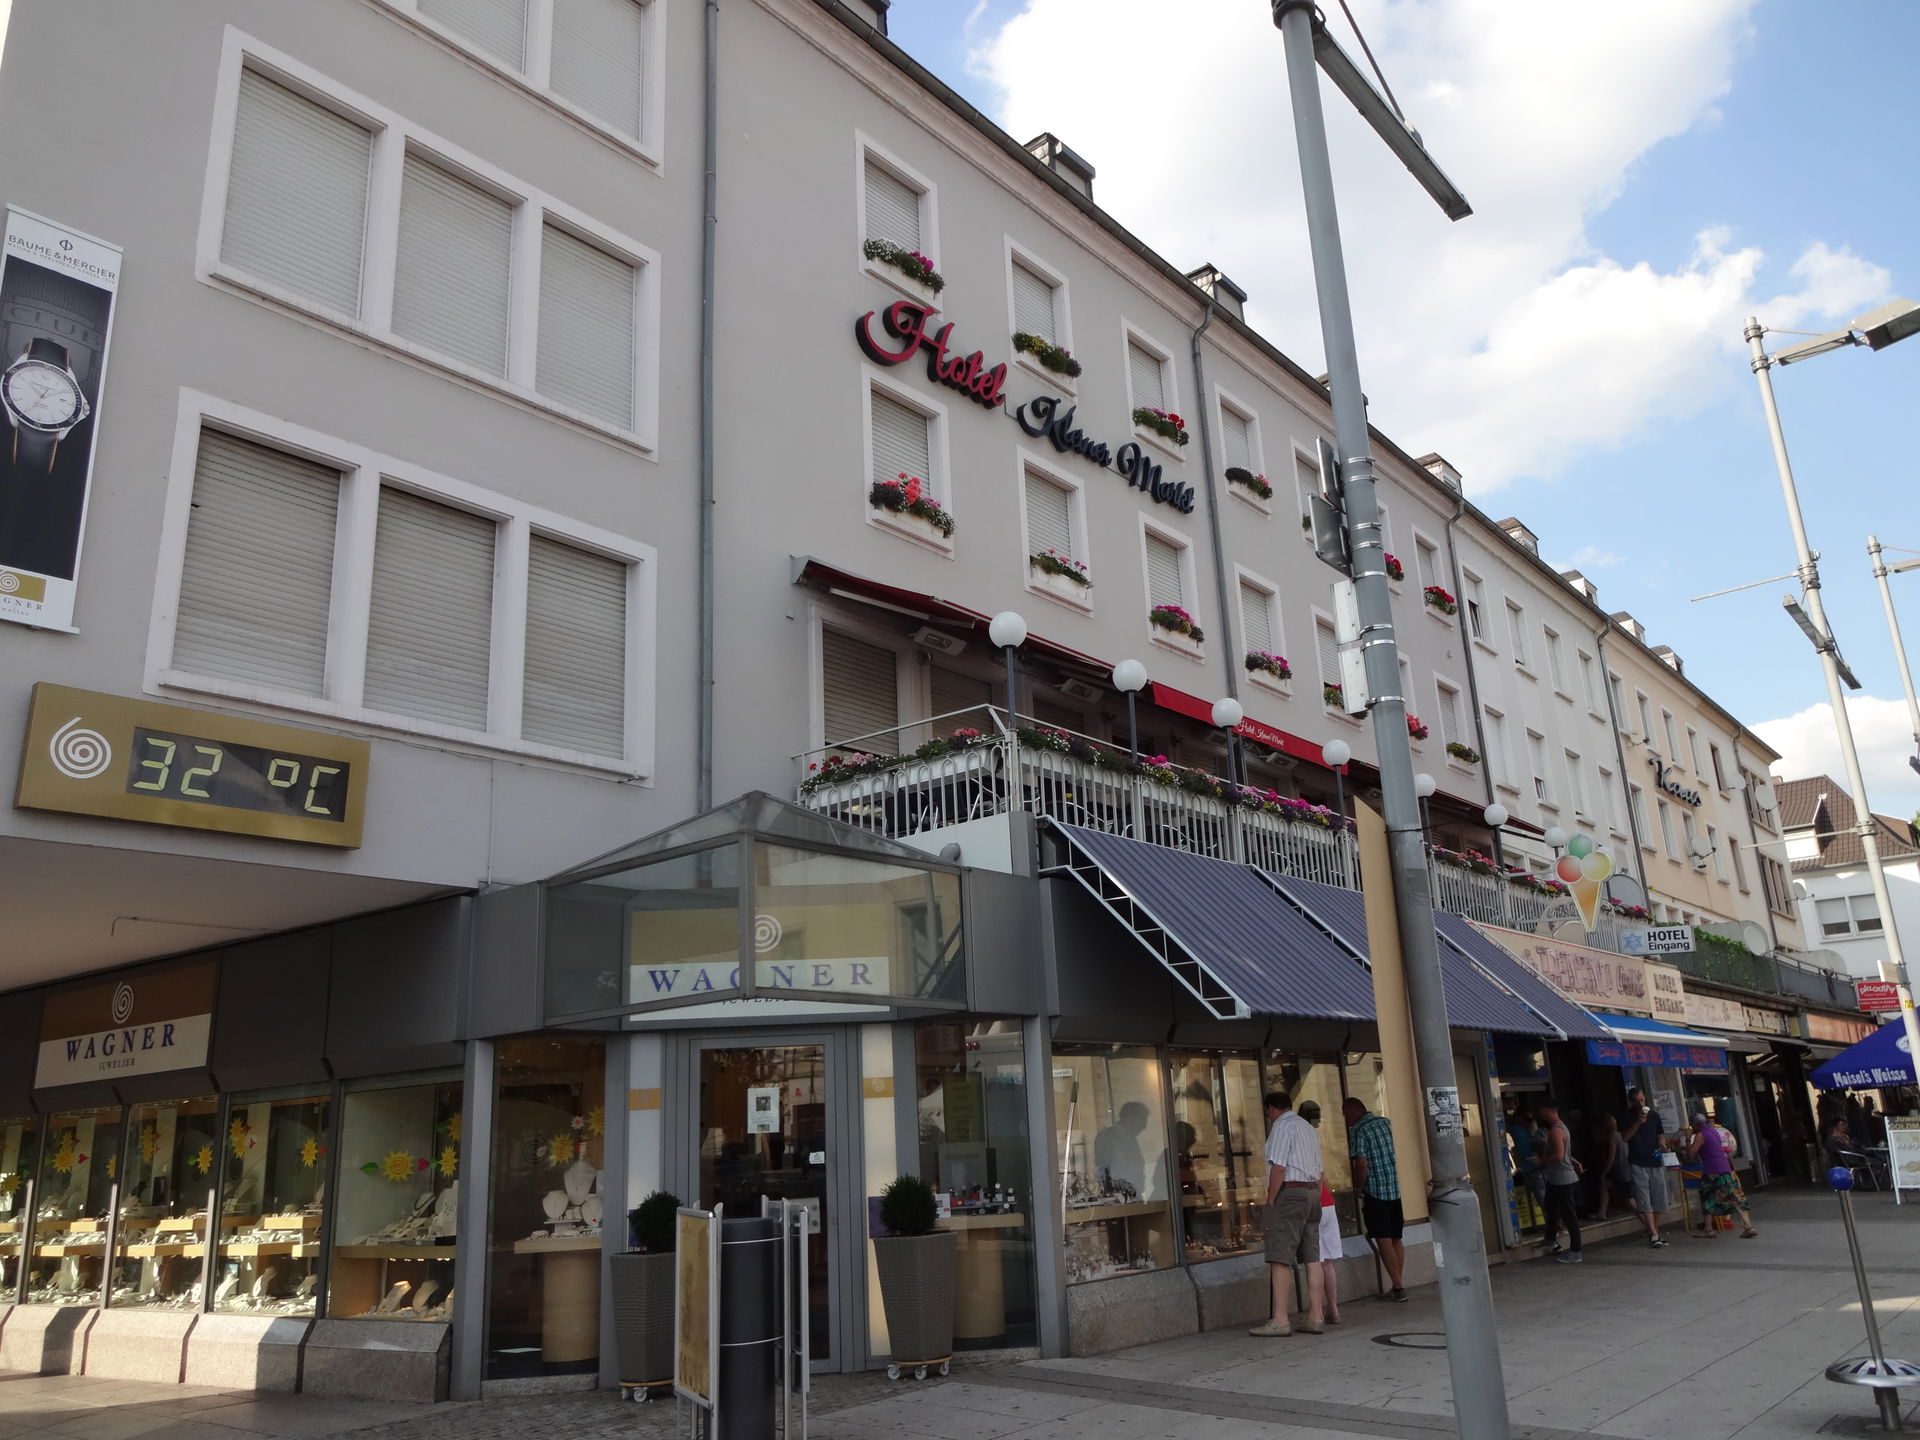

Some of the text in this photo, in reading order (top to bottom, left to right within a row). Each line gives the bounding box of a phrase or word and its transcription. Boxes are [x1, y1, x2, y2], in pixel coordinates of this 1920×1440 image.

[9, 234, 116, 280] BAUME & MERCIER
[855, 300, 1007, 410] Hotel
[3, 597, 42, 611] GNER
[133, 737, 224, 798] 32
[1647, 929, 1689, 942] HOTEL
[1648, 940, 1690, 952] Eingang
[66, 1023, 175, 1062] WAGNER
[99, 1058, 136, 1072] JUWELIER
[1832, 1069, 1872, 1087] Maisel's
[1871, 1067, 1908, 1083] Weisse
